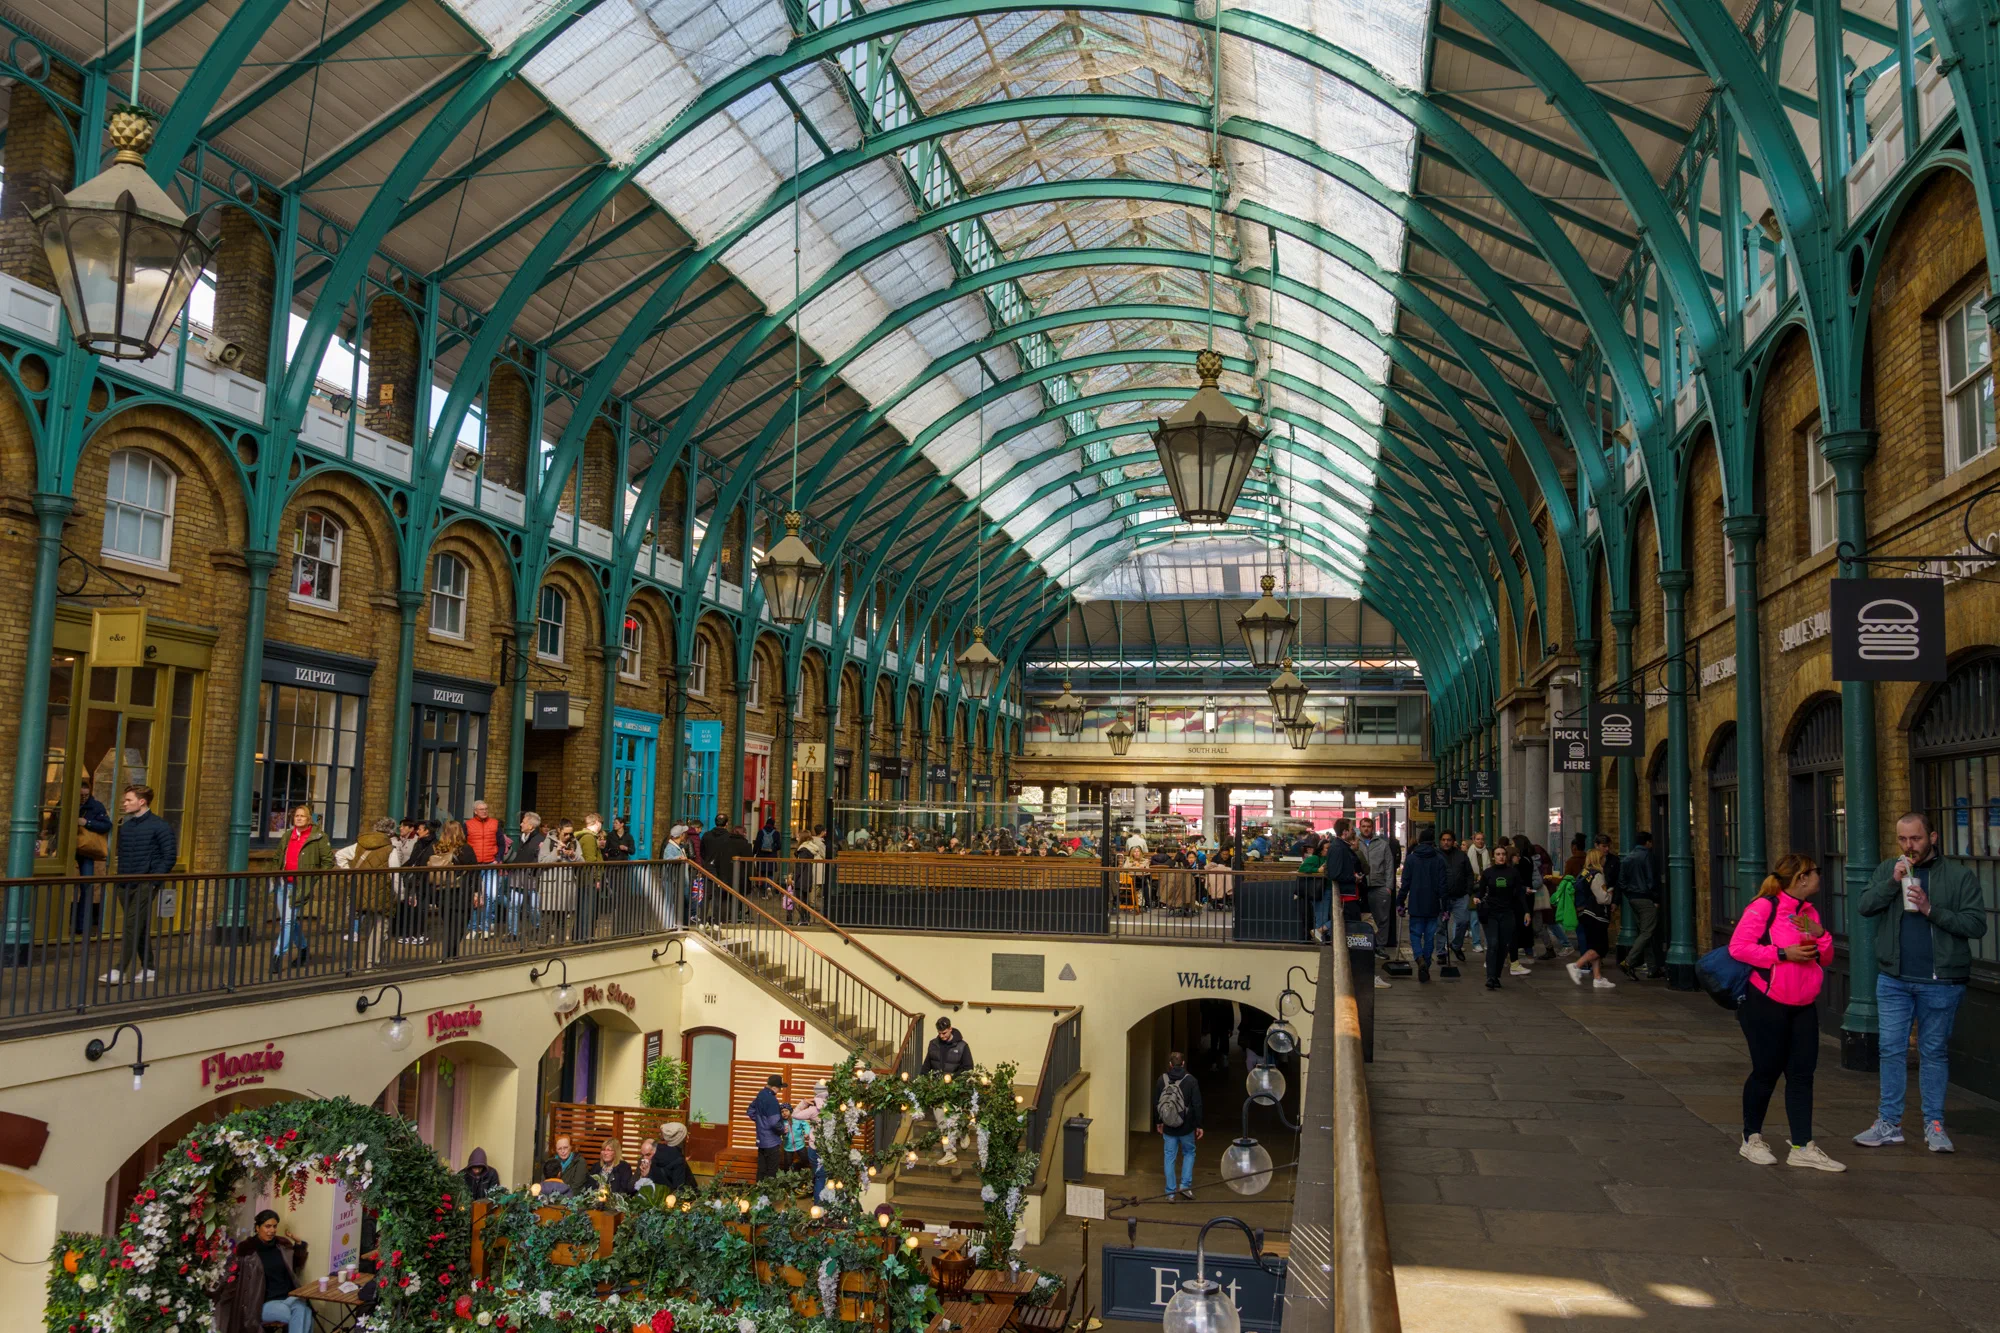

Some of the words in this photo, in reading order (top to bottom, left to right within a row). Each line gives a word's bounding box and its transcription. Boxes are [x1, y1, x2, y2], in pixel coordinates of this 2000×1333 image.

[294, 667, 336, 686] IZIPIZI
[433, 689, 464, 705] IZIPIZI
[1554, 730, 1580, 740] PICK
[1563, 760, 1591, 770] HERE
[1176, 972, 1252, 991] Whittard
[583, 984, 604, 1006] Pie
[606, 982, 636, 1013] Shop
[428, 1003, 483, 1037] Floozie
[201, 1042, 285, 1088] Floozie
[340, 1209, 355, 1220] HOT
